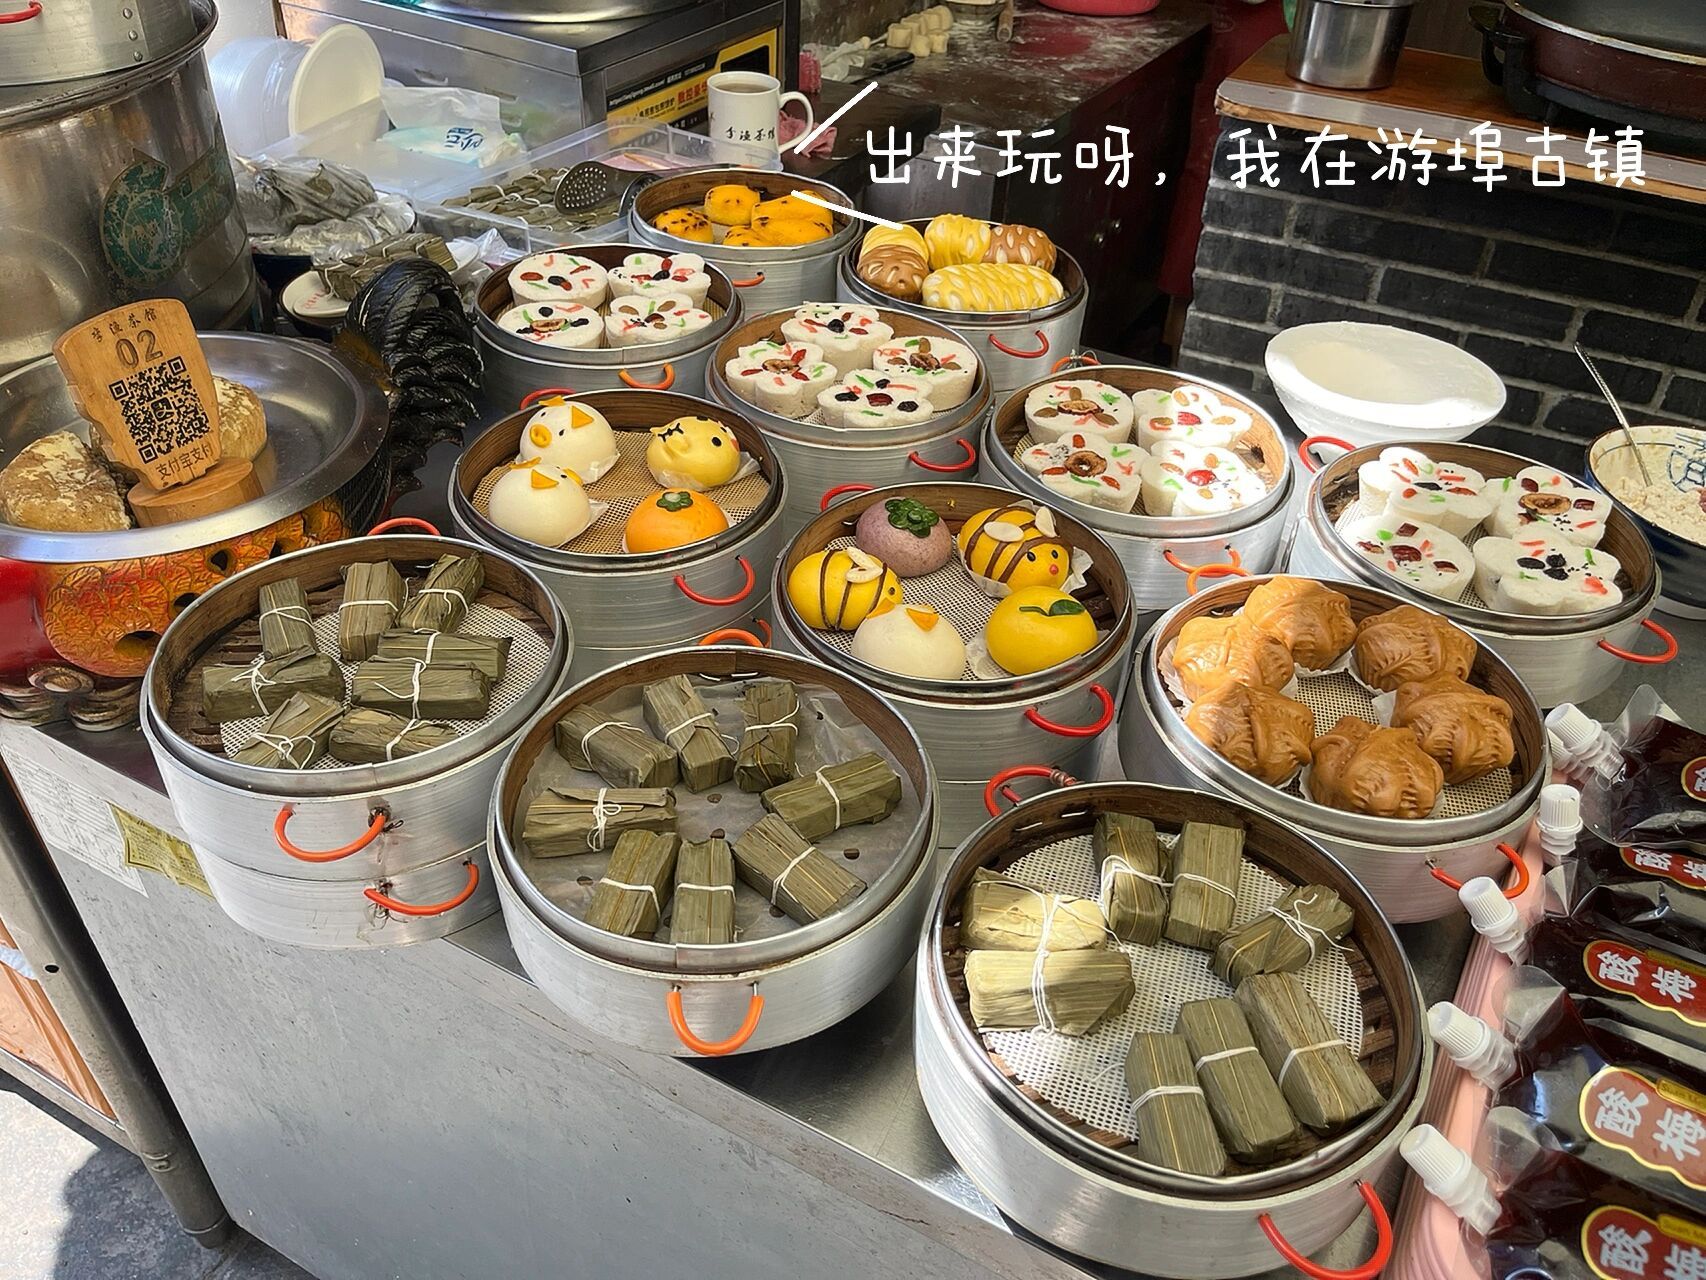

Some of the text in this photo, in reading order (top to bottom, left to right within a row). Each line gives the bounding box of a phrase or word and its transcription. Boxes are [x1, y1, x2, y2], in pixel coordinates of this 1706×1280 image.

[115, 329, 163, 369] 02
[155, 442, 214, 481] 支付宝支付
[1596, 950, 1697, 1003] 酸梅
[1594, 1086, 1706, 1162] 酸梅
